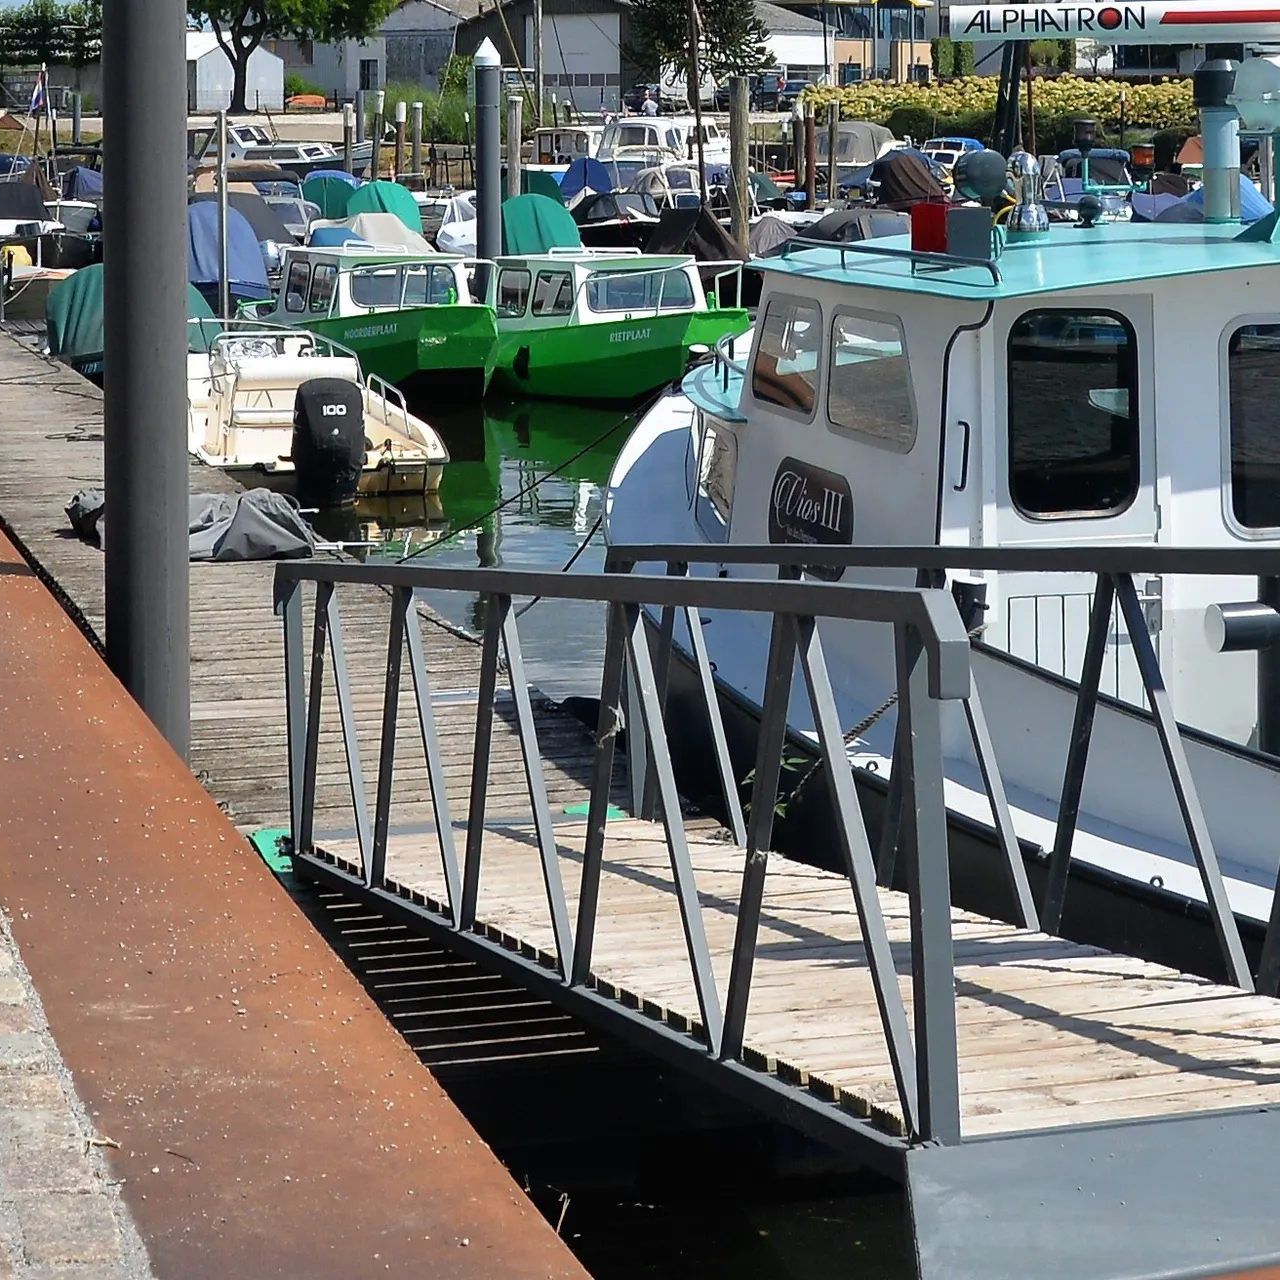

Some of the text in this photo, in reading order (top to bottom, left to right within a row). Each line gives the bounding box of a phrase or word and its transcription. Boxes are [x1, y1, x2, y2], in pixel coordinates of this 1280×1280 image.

[963, 5, 1146, 34] ALPHATRON
[343, 322, 398, 340] NOORDERPLAAT
[609, 328, 651, 343] RIETPLAAT
[322, 404, 347, 416] 100
